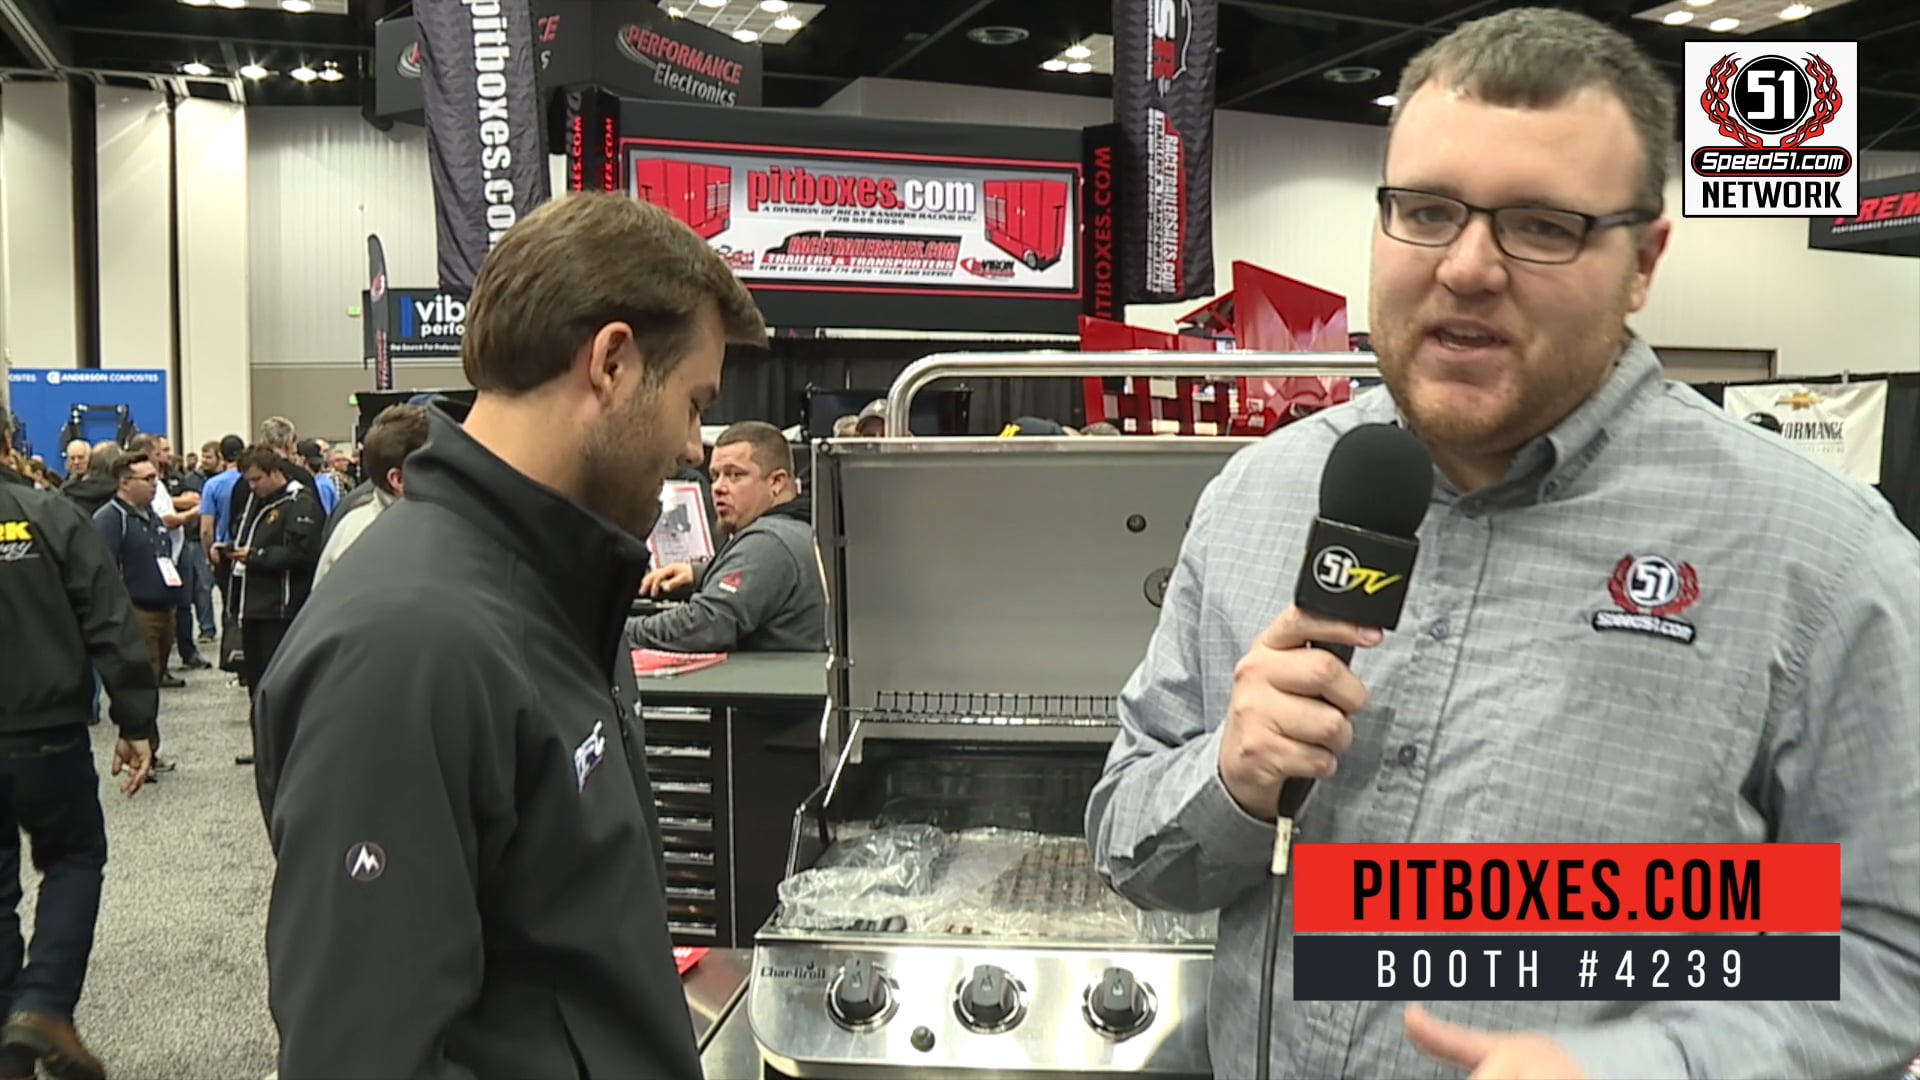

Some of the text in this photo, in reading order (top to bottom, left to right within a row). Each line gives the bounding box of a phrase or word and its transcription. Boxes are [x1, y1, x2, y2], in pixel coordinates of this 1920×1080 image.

[626, 24, 744, 85] PERFORMANCE
[653, 61, 737, 108] Electronics
[747, 166, 976, 213] pitboxes.com
[1163, 134, 1180, 293] RACETRAILERSALES.COM
[767, 253, 833, 265] TRAILERS
[850, 255, 955, 269] TRANSPORTERS
[61, 372, 108, 382] ANDERSON
[109, 372, 159, 382] COMPOSITES
[1632, 564, 1670, 600] 51
